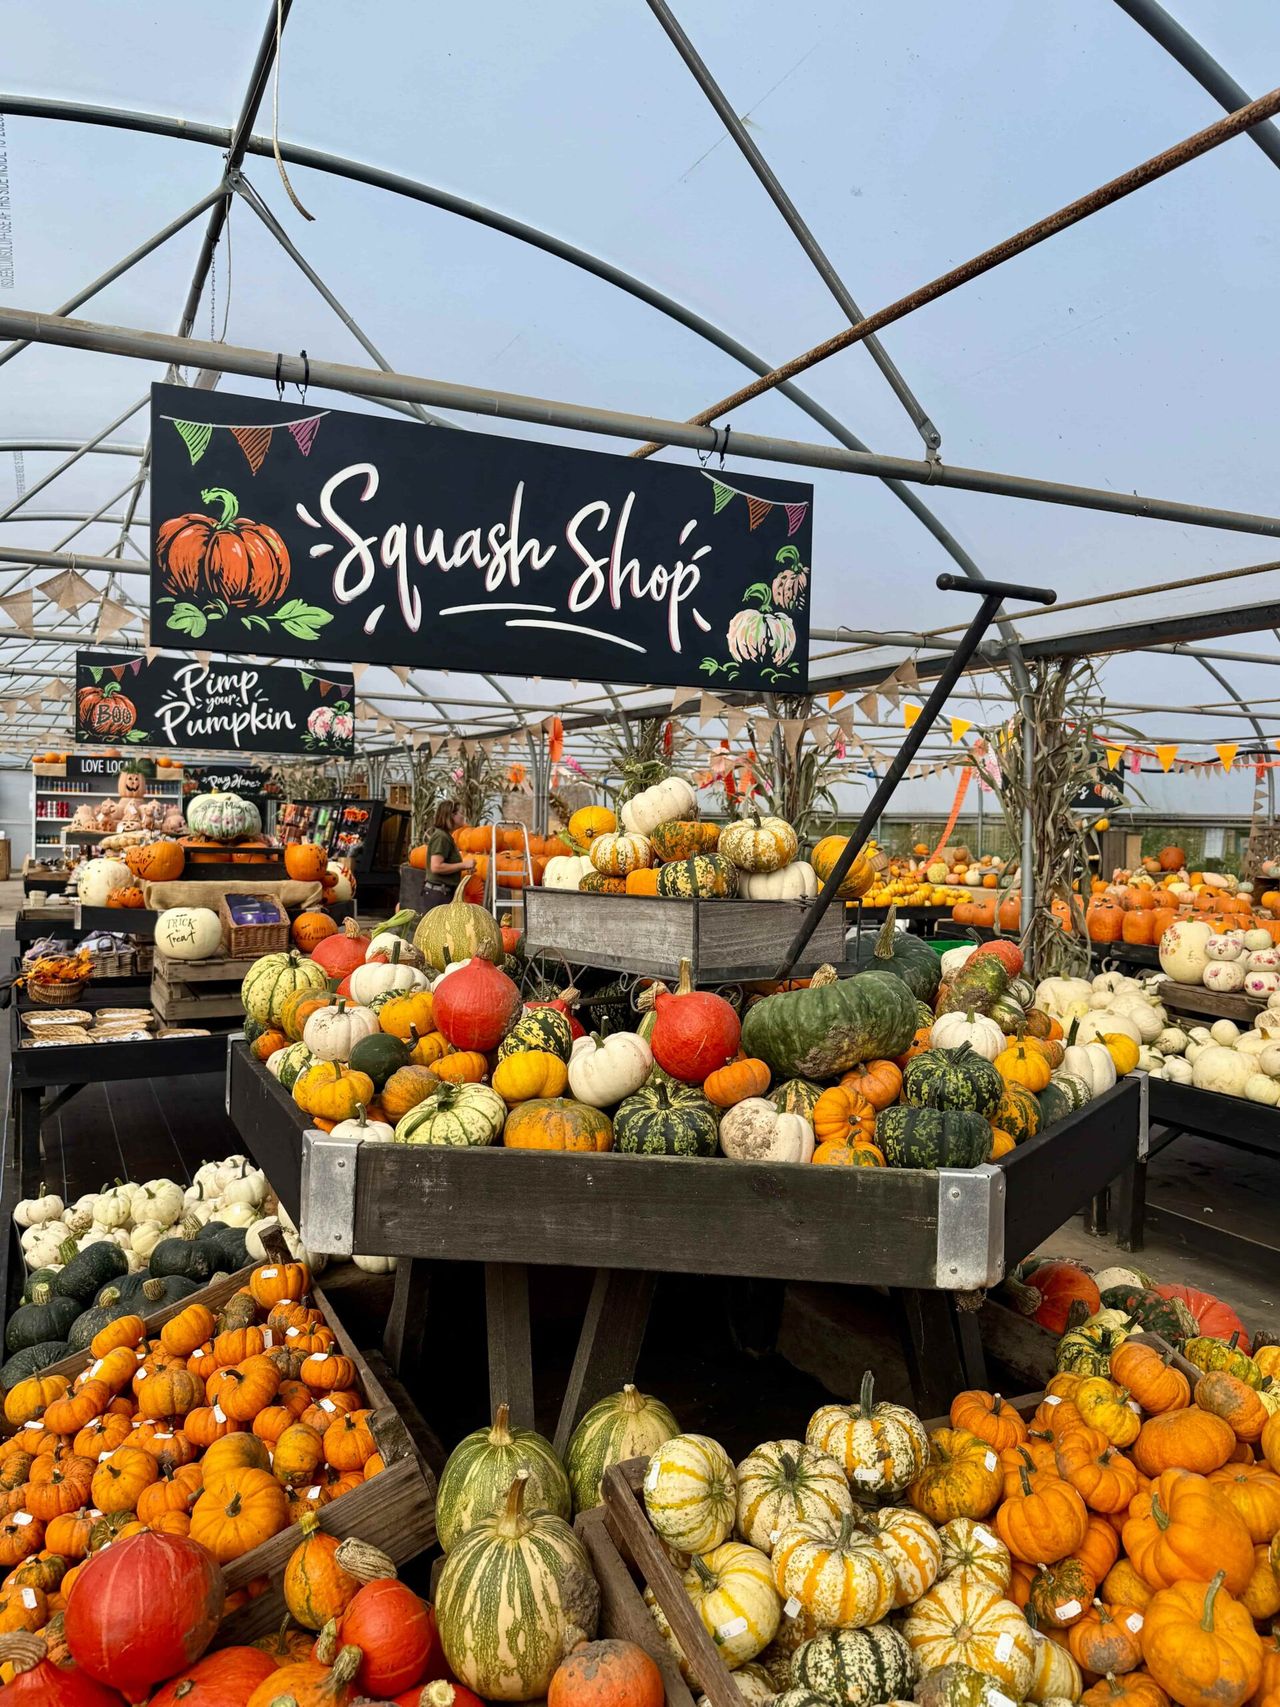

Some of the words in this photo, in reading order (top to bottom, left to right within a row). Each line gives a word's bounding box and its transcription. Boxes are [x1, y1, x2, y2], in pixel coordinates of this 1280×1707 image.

[319, 462, 557, 634] Squash
[565, 491, 701, 653] Shop
[173, 662, 258, 707] Pimp
[206, 692, 235, 712] your
[154, 701, 296, 748] Pumpkin
[81, 759, 104, 773] LOVE
[107, 760, 132, 774] LOC
[208, 775, 231, 790] Pay
[231, 773, 256, 788] Here
[167, 918, 197, 930] TRICK
[166, 930, 196, 948] Treat
